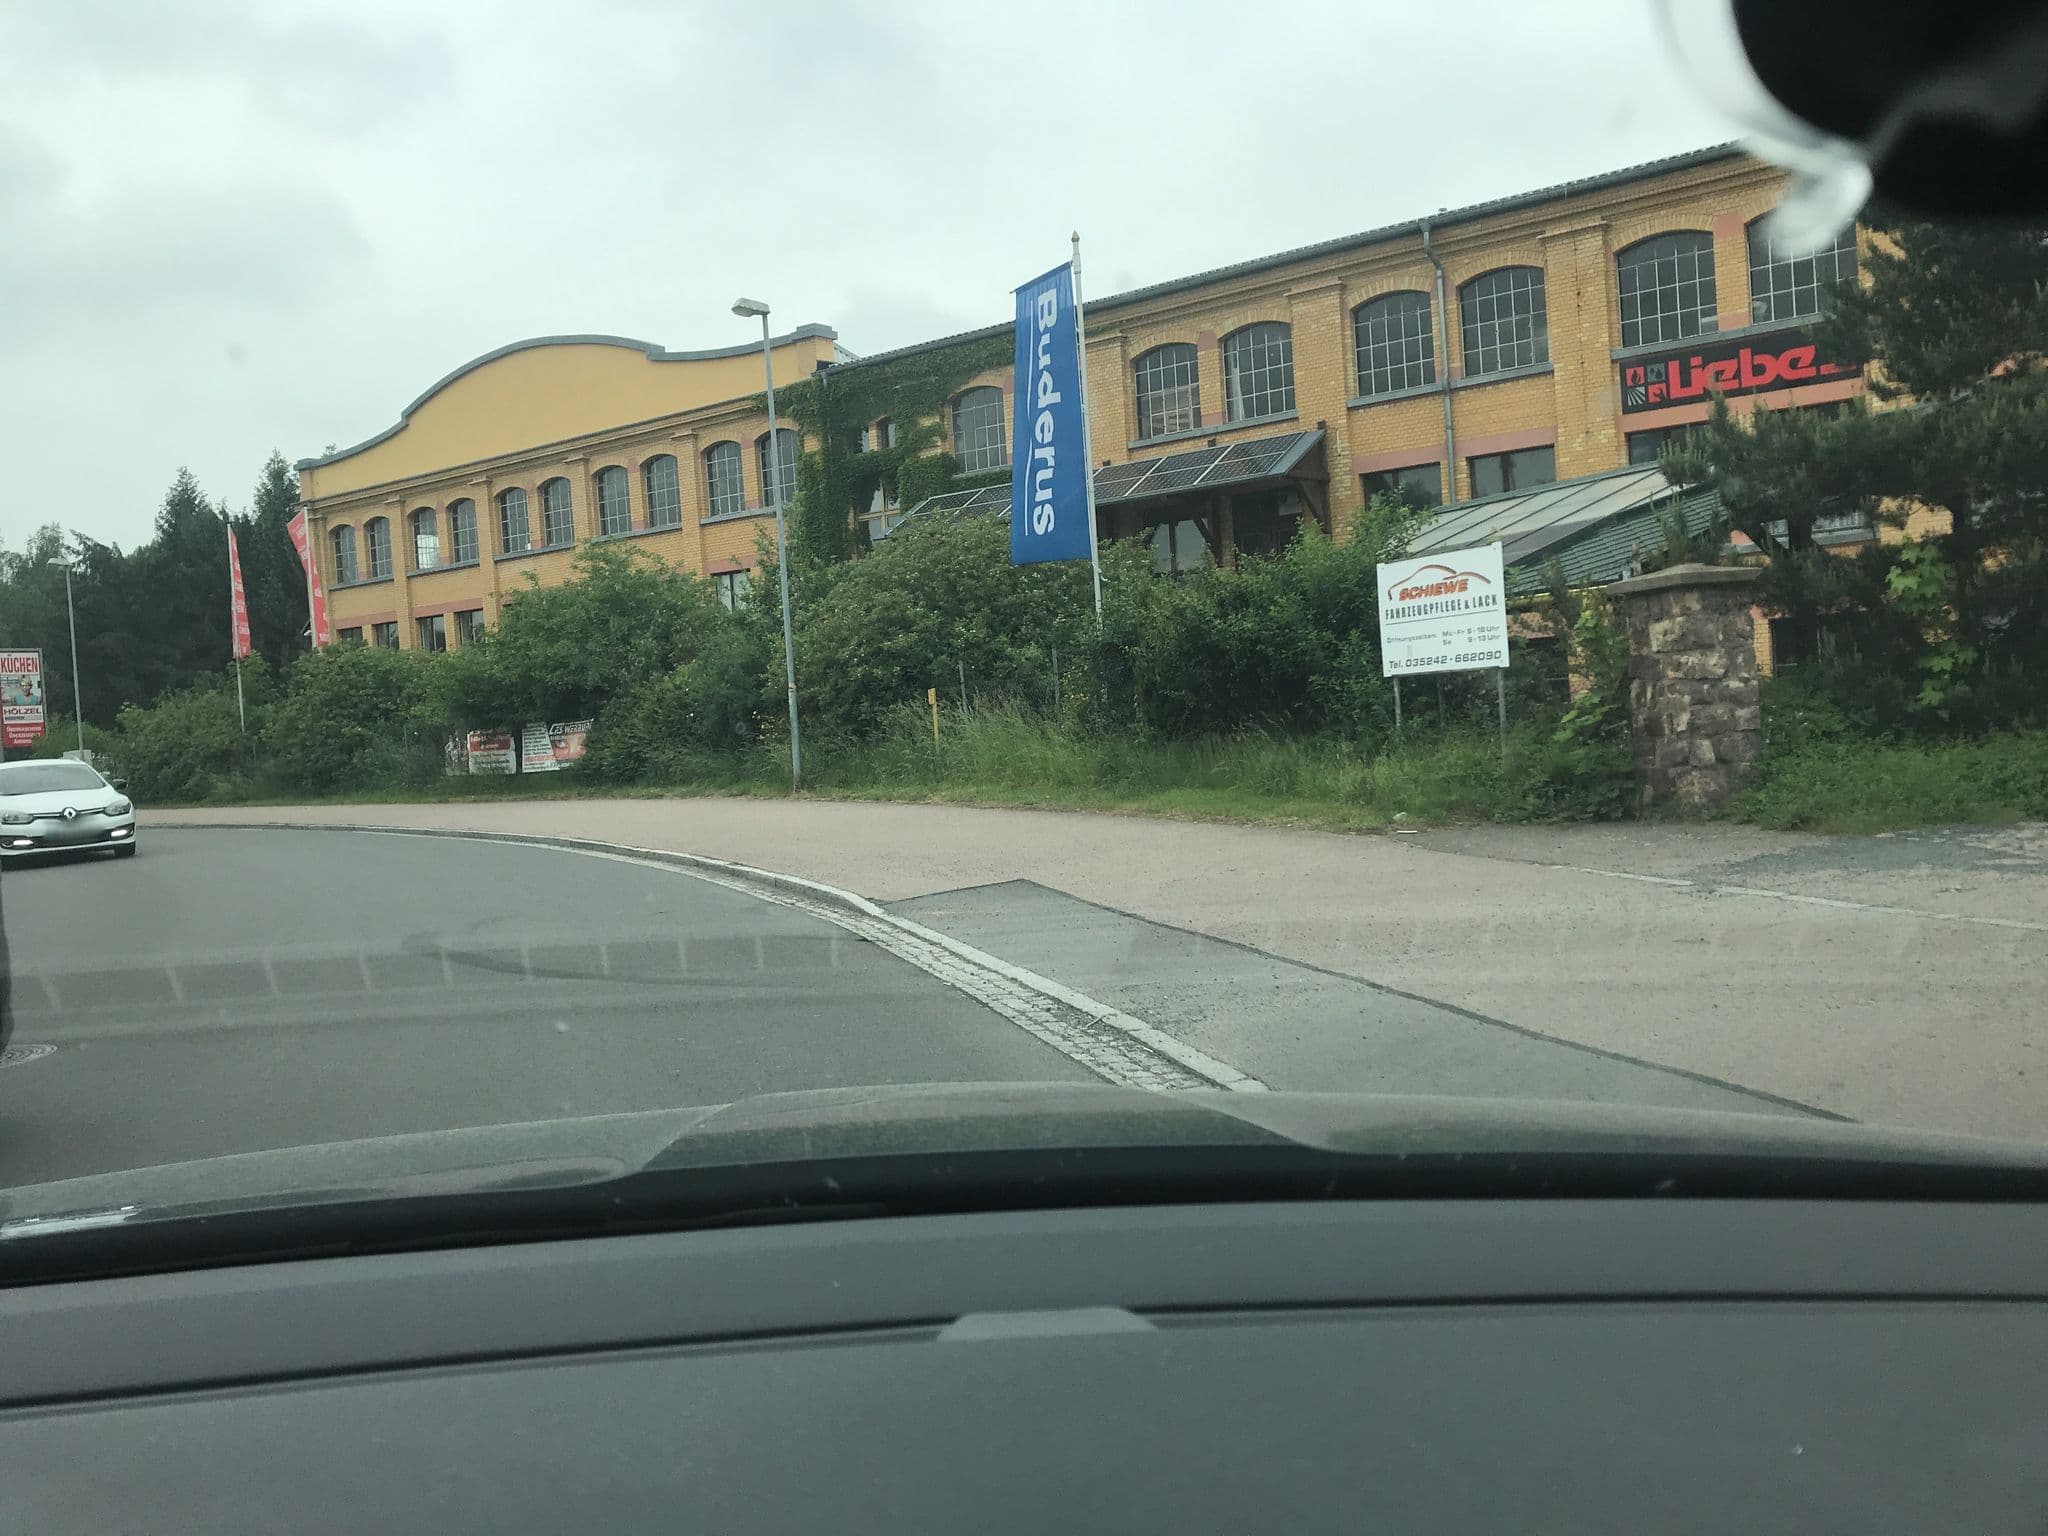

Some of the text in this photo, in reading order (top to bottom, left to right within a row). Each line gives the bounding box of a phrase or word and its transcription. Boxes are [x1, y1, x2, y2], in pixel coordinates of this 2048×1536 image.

[1032, 287, 1062, 537] Buderus
[1398, 578, 1469, 602] SCHIEWE
[1385, 598, 1462, 620] FAHRZEUGPFLEGE
[1472, 594, 1498, 608] LACK
[0, 654, 38, 673] KÜCHEN
[1389, 660, 1404, 669] Tel.
